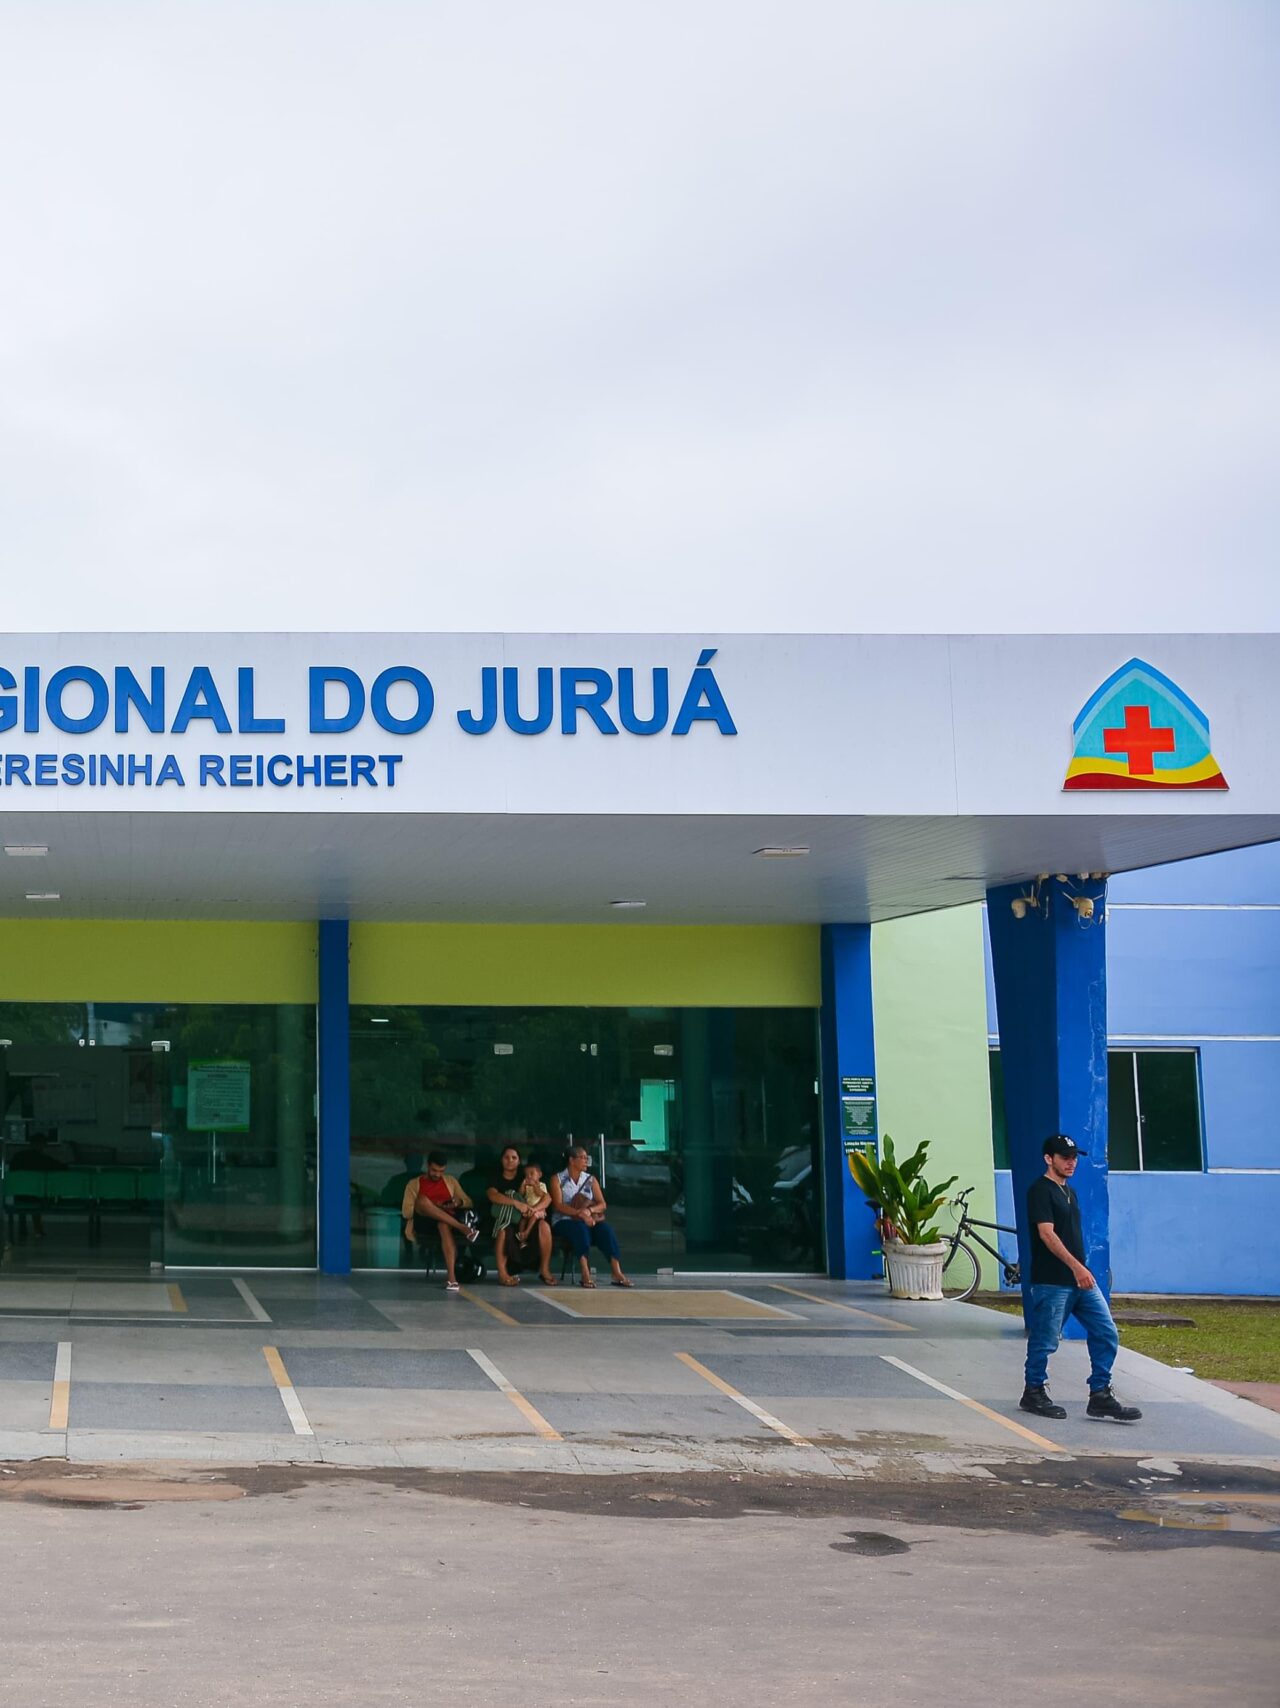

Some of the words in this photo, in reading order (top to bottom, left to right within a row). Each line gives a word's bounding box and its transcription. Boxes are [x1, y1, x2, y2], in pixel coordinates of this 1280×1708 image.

[309, 665, 435, 736] DO
[456, 648, 738, 736] JURUÁ
[199, 754, 403, 788] REICHERT
